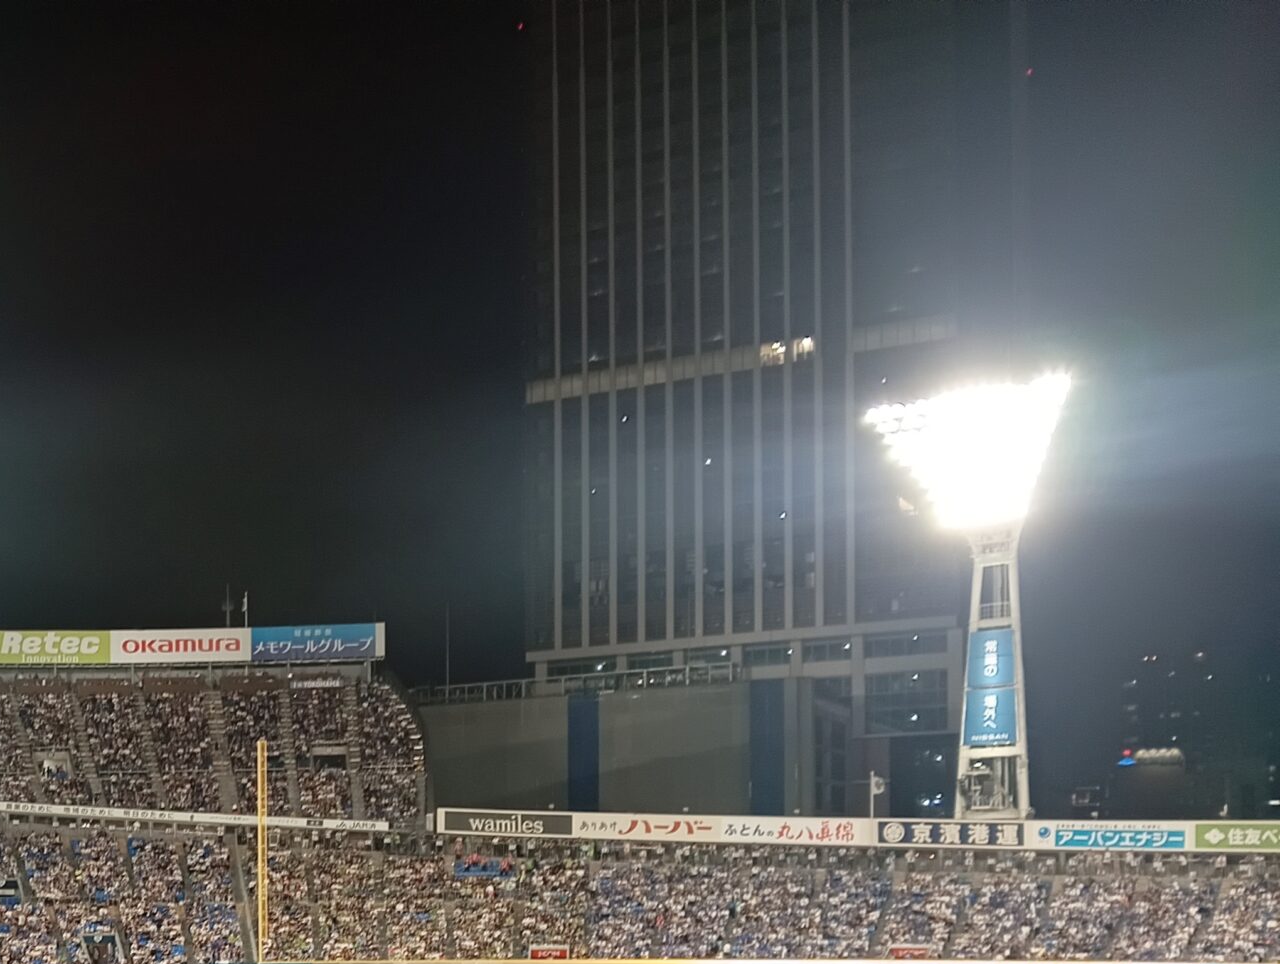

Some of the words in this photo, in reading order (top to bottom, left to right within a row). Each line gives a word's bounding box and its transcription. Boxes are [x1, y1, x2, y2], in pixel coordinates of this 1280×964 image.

[1, 631, 100, 655] Retec
[253, 636, 374, 655] メモワールグループ
[470, 815, 544, 834] wamiles
[1058, 830, 1184, 847] アーバンエナジー
